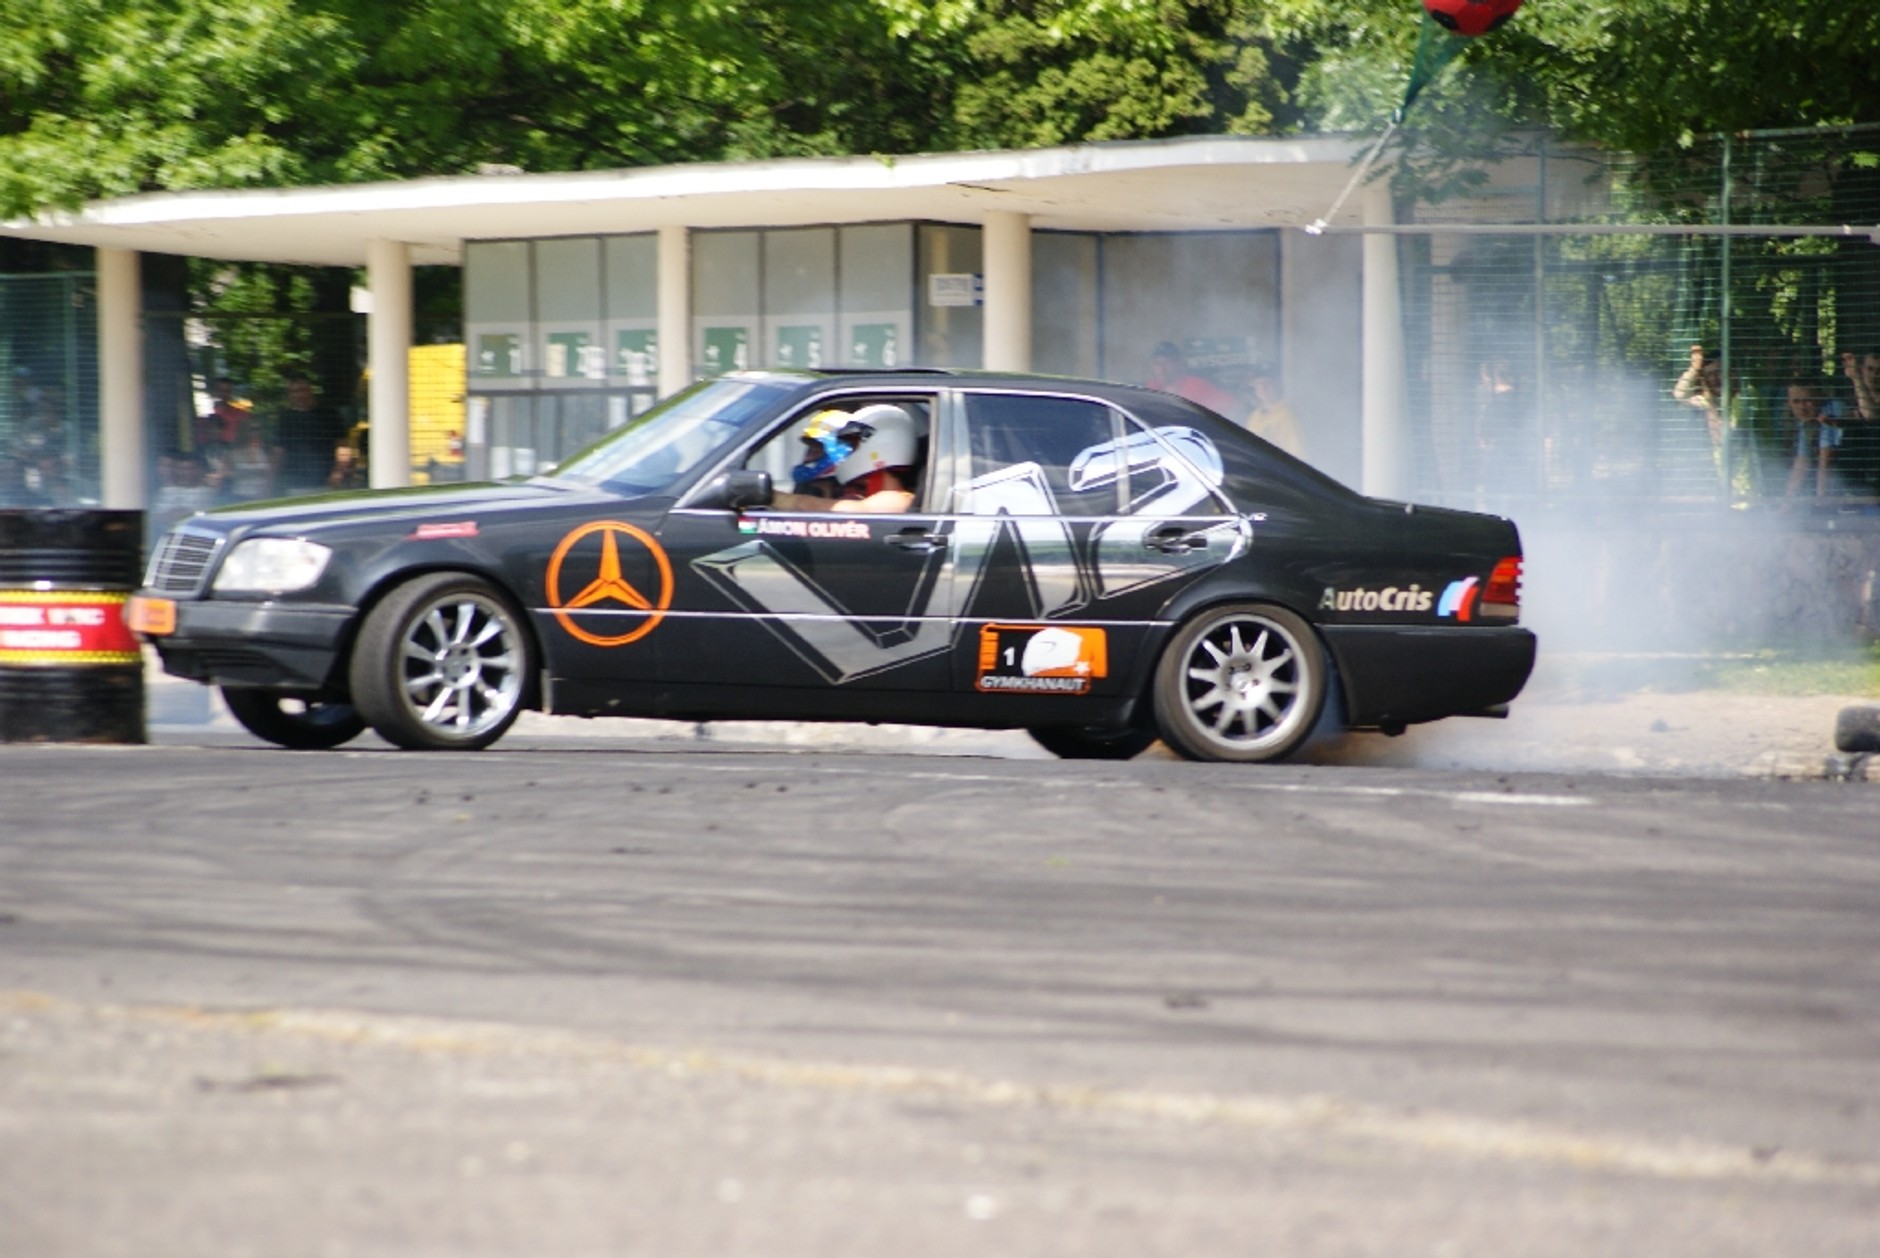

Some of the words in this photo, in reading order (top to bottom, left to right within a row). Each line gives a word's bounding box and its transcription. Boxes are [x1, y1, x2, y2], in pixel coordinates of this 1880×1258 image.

[808, 520, 870, 538] OLIVÉR
[1318, 584, 1434, 611] AutoCris
[1003, 646, 1016, 666] 1
